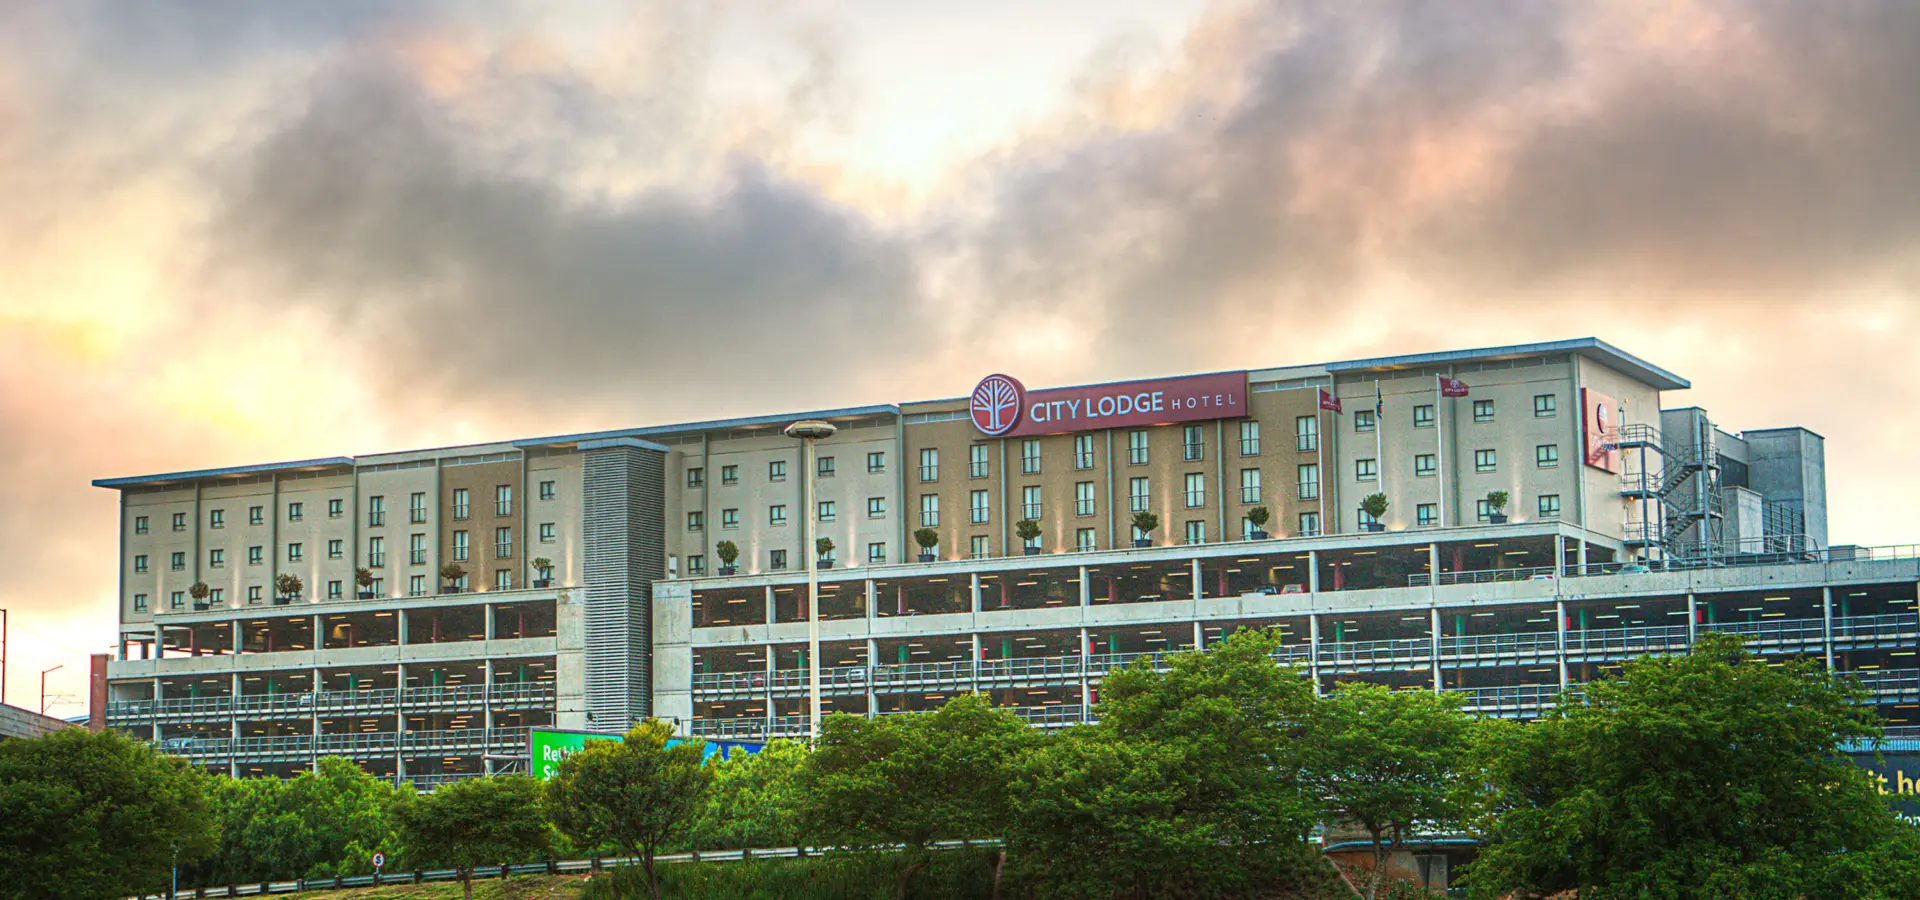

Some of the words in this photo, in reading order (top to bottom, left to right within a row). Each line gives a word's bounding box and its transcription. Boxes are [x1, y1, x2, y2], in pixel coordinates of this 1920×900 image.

[1030, 399, 1080, 422] CITY
[1086, 391, 1164, 418] LODGE
[1171, 394, 1235, 410] HOTEL
